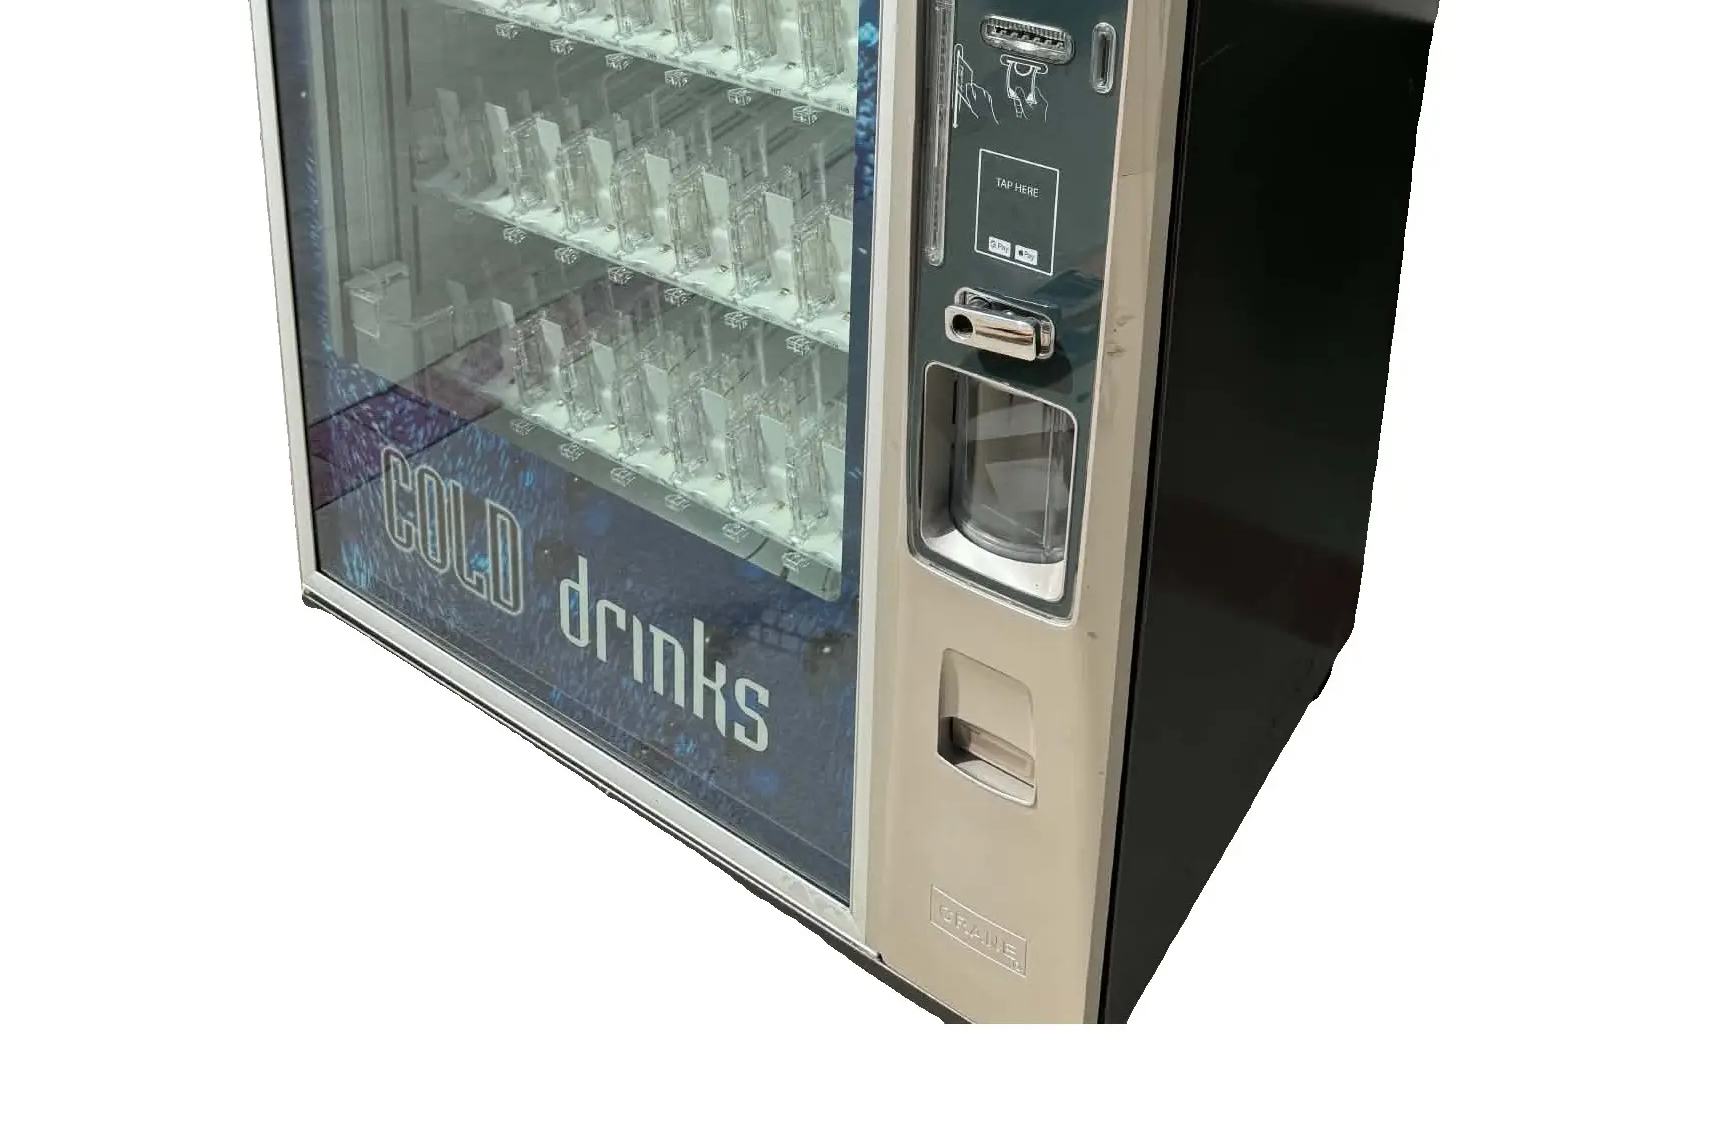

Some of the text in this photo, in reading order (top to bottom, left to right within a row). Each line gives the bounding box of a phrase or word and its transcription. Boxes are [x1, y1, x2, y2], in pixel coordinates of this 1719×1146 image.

[995, 176, 1040, 198] TAP HERE
[381, 446, 769, 753] COLD drinks
